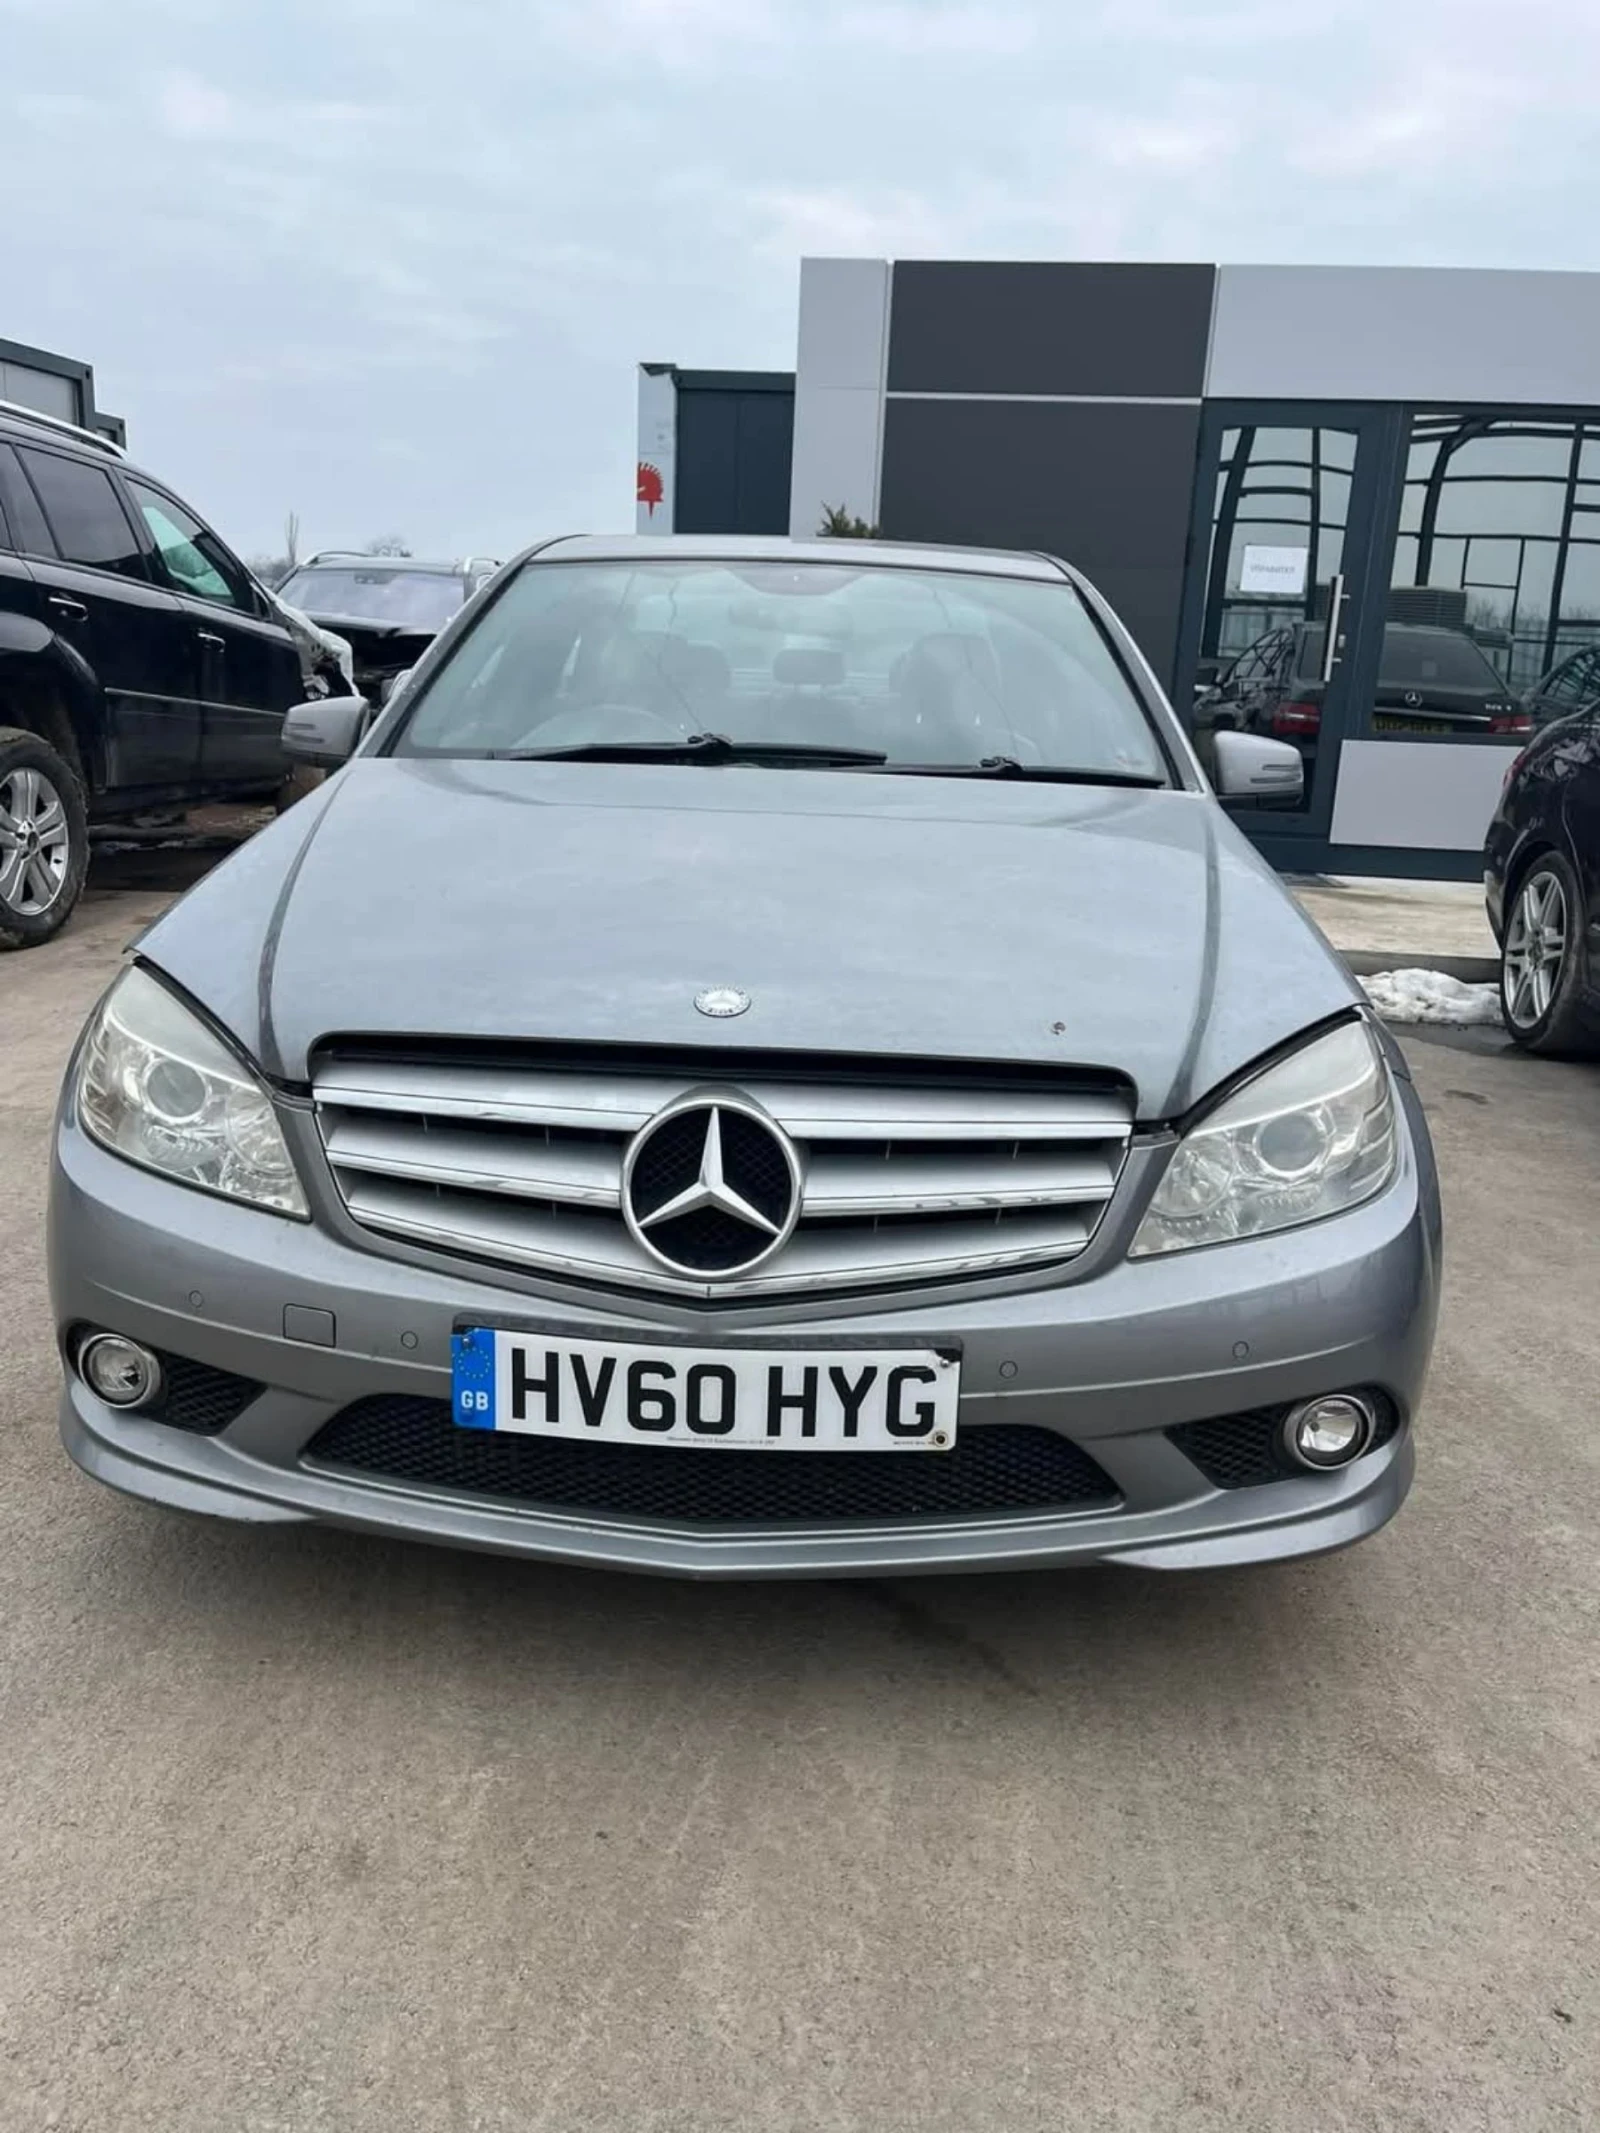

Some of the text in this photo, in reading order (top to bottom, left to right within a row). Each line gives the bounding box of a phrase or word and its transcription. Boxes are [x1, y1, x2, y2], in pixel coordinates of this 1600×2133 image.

[461, 1390, 489, 1411] GB
[511, 1348, 937, 1437] HV60 HYG
